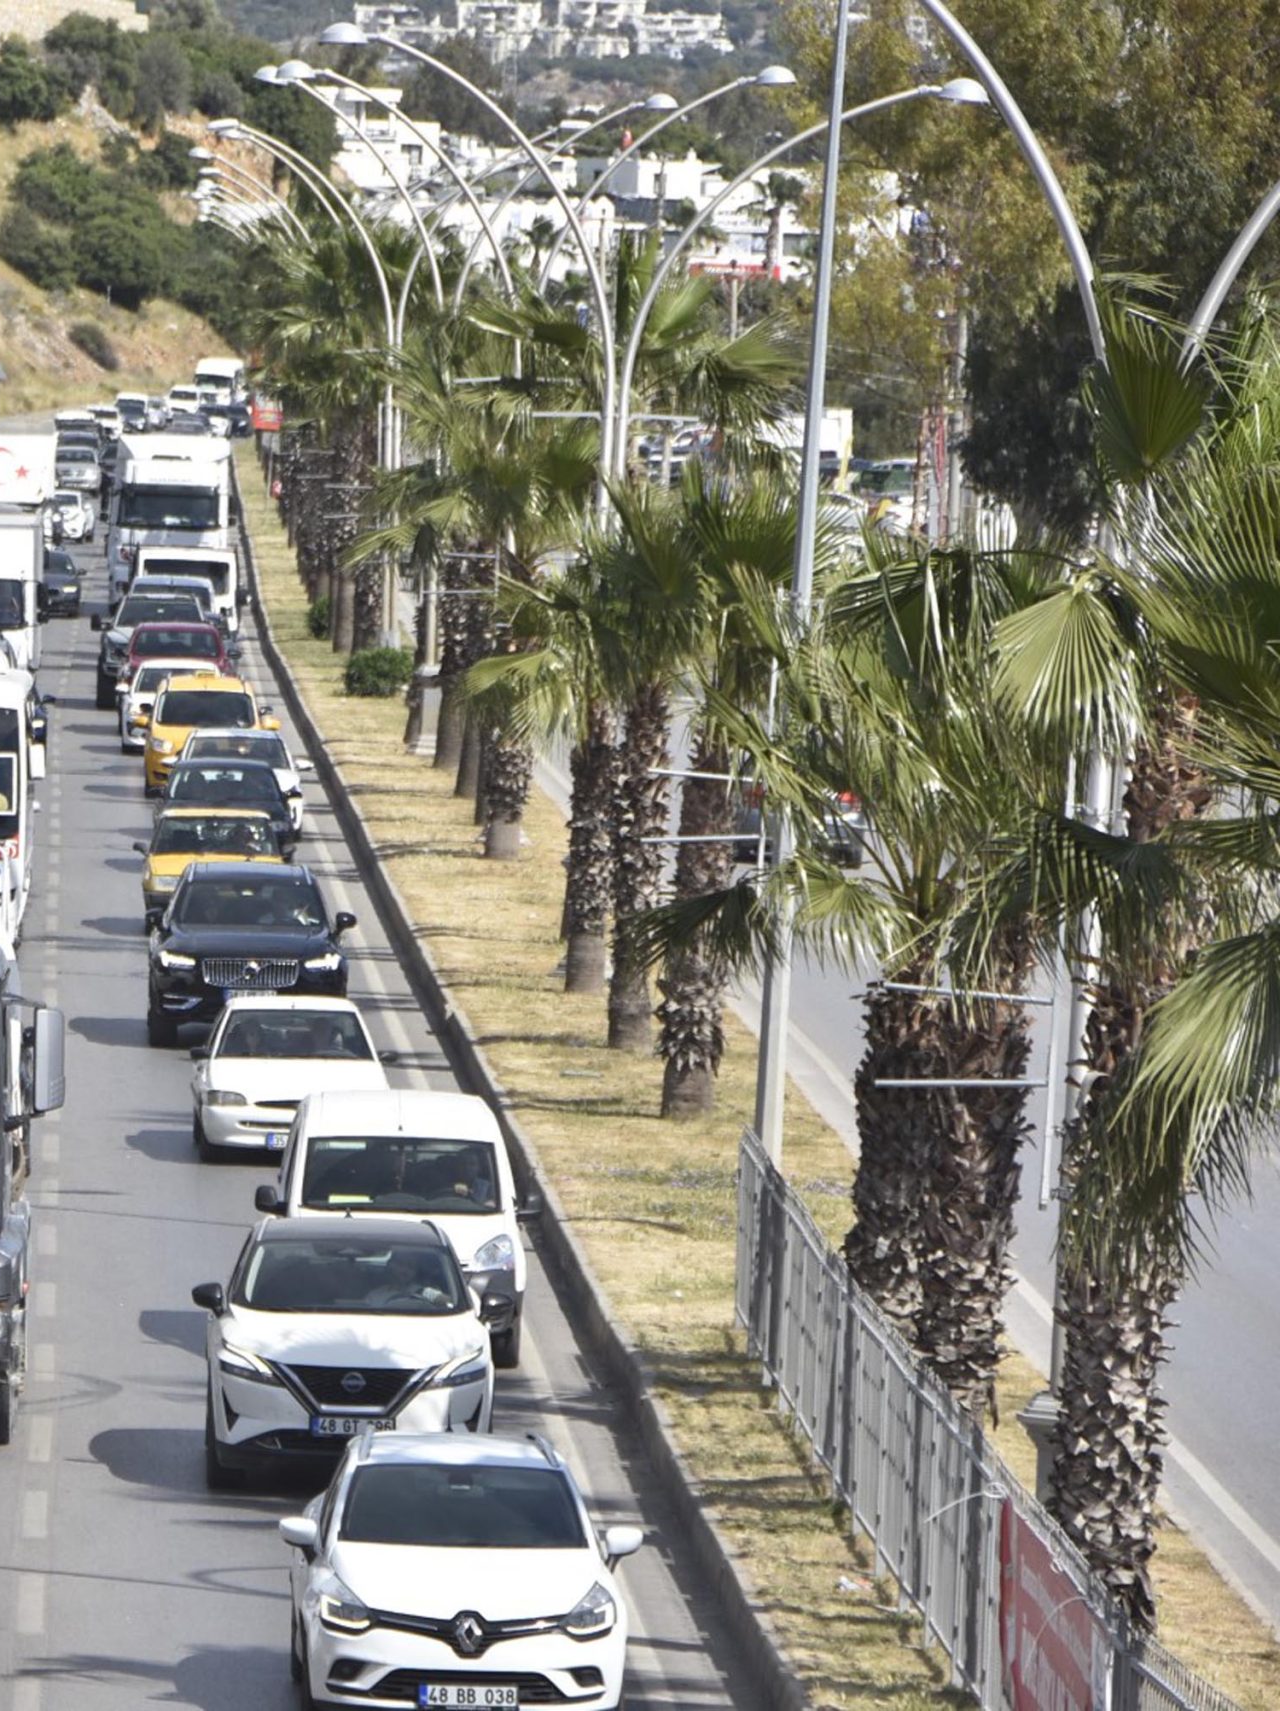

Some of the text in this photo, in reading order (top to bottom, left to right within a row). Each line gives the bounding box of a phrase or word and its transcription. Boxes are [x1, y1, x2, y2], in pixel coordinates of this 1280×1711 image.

[320, 1419, 336, 1432] 48
[343, 1419, 359, 1433] GT
[429, 1687, 514, 1704] 48 BB 038
